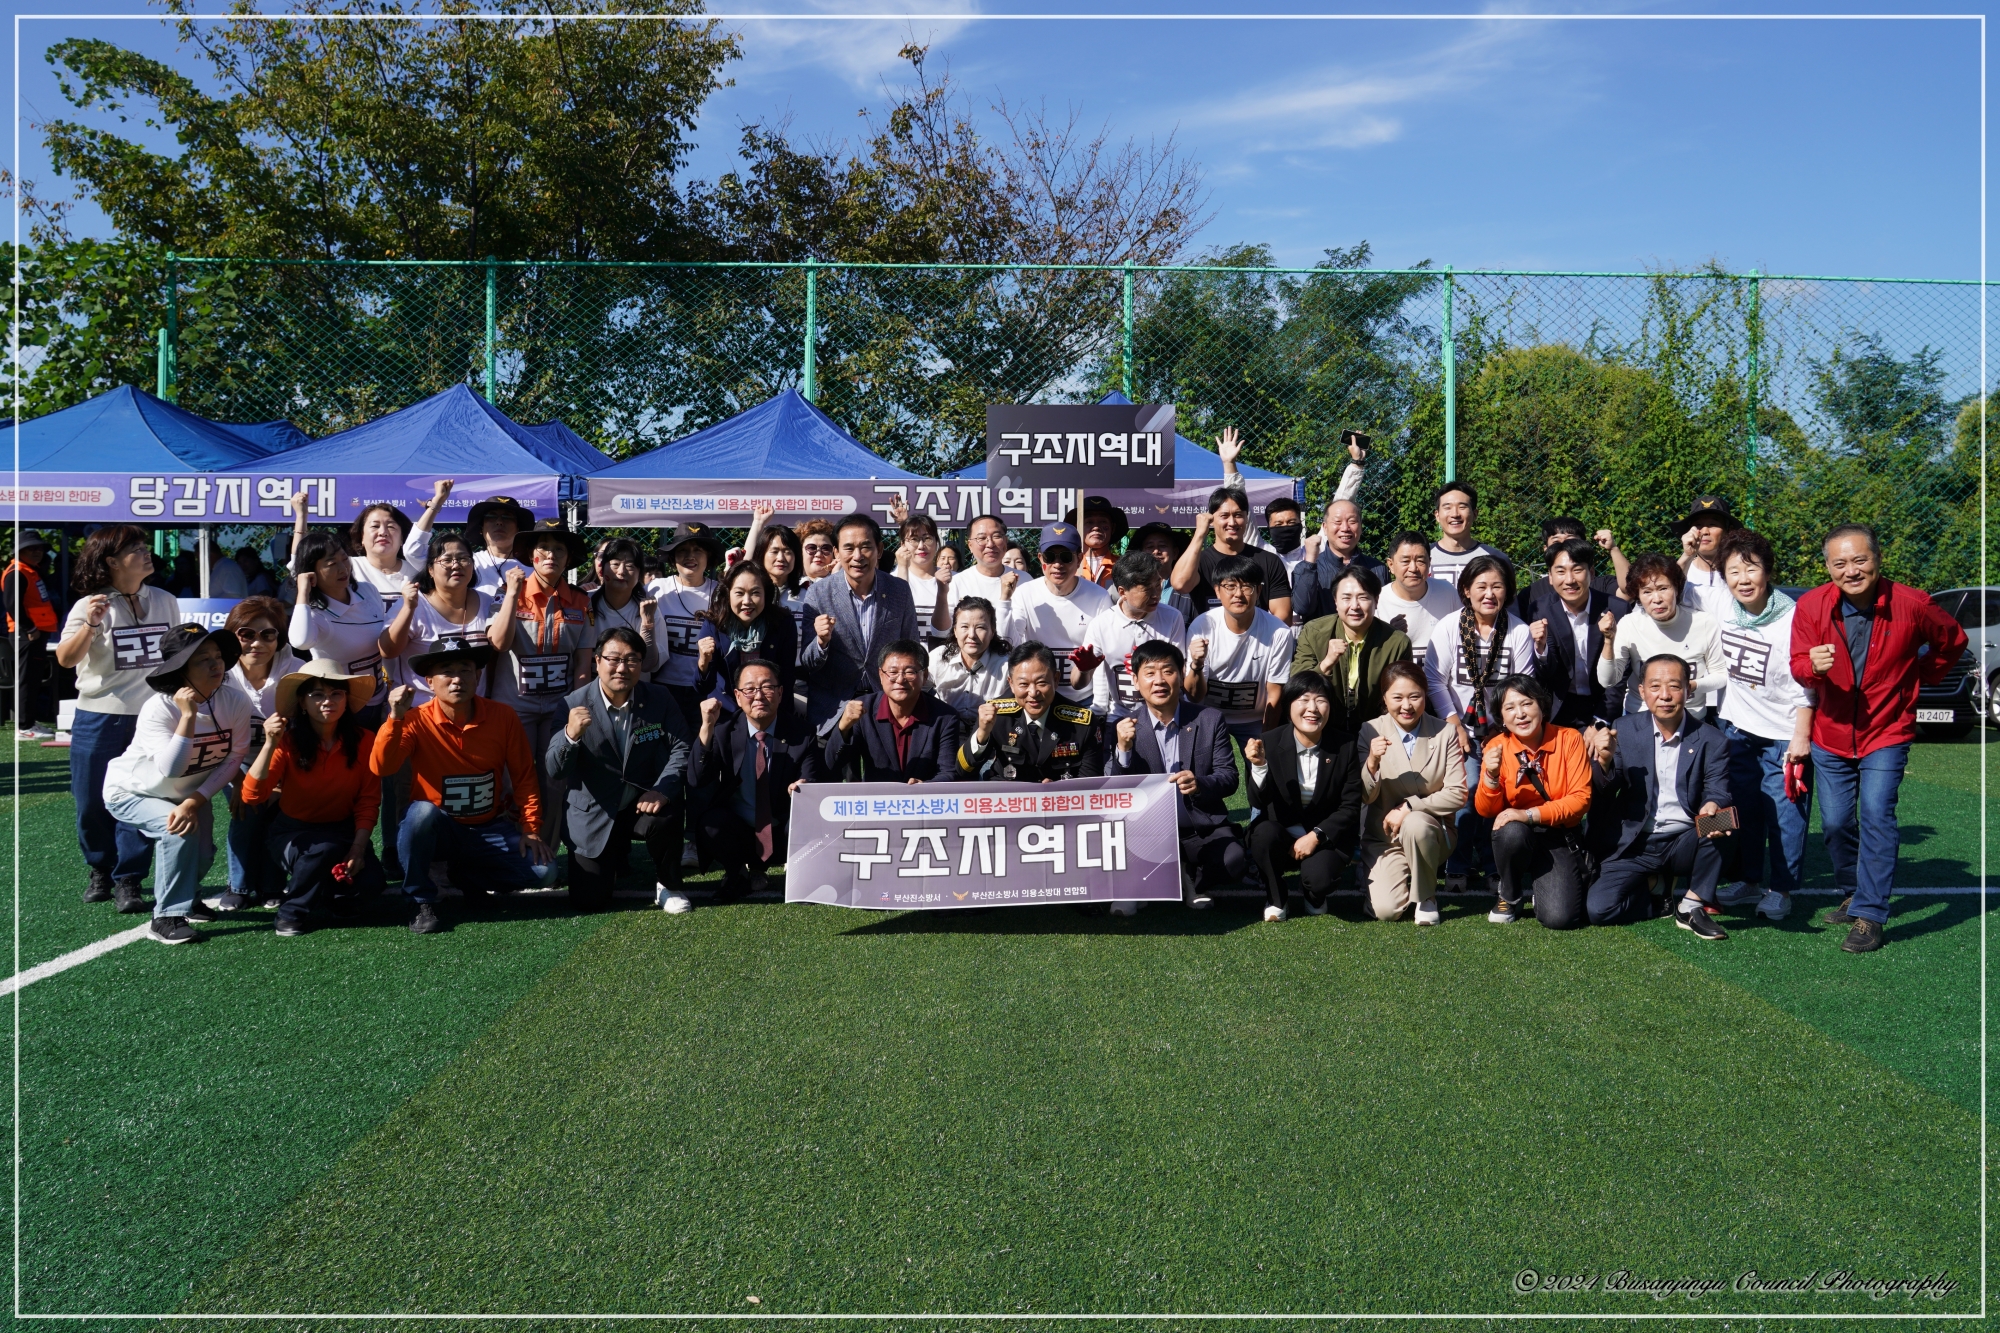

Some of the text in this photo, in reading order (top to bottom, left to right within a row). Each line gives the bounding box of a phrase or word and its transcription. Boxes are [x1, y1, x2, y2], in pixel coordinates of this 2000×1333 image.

[999, 432, 1162, 466] 구조지역대
[33, 490, 65, 502] 화합의
[69, 490, 101, 502] 한마당
[130, 477, 336, 517] 당감지역대
[620, 498, 647, 510] 제1회
[650, 498, 714, 510] 부산진소방서
[775, 499, 807, 511] 화합의
[811, 499, 843, 511] 한마당
[871, 485, 1075, 524] 구조지역대
[1253, 506, 1266, 514] 연합
[1721, 642, 1767, 679] 구조
[521, 664, 567, 689] 구조
[1926, 711, 1951, 721] 2407
[444, 781, 494, 811] 구조
[833, 792, 1133, 816] 제1회 부산진소방서 의용소방대 화합의 한마당
[839, 820, 1127, 880] 구조지역대
[894, 886, 1087, 903] 부산진소방서 부산진소방서 의용소방대 연합회
